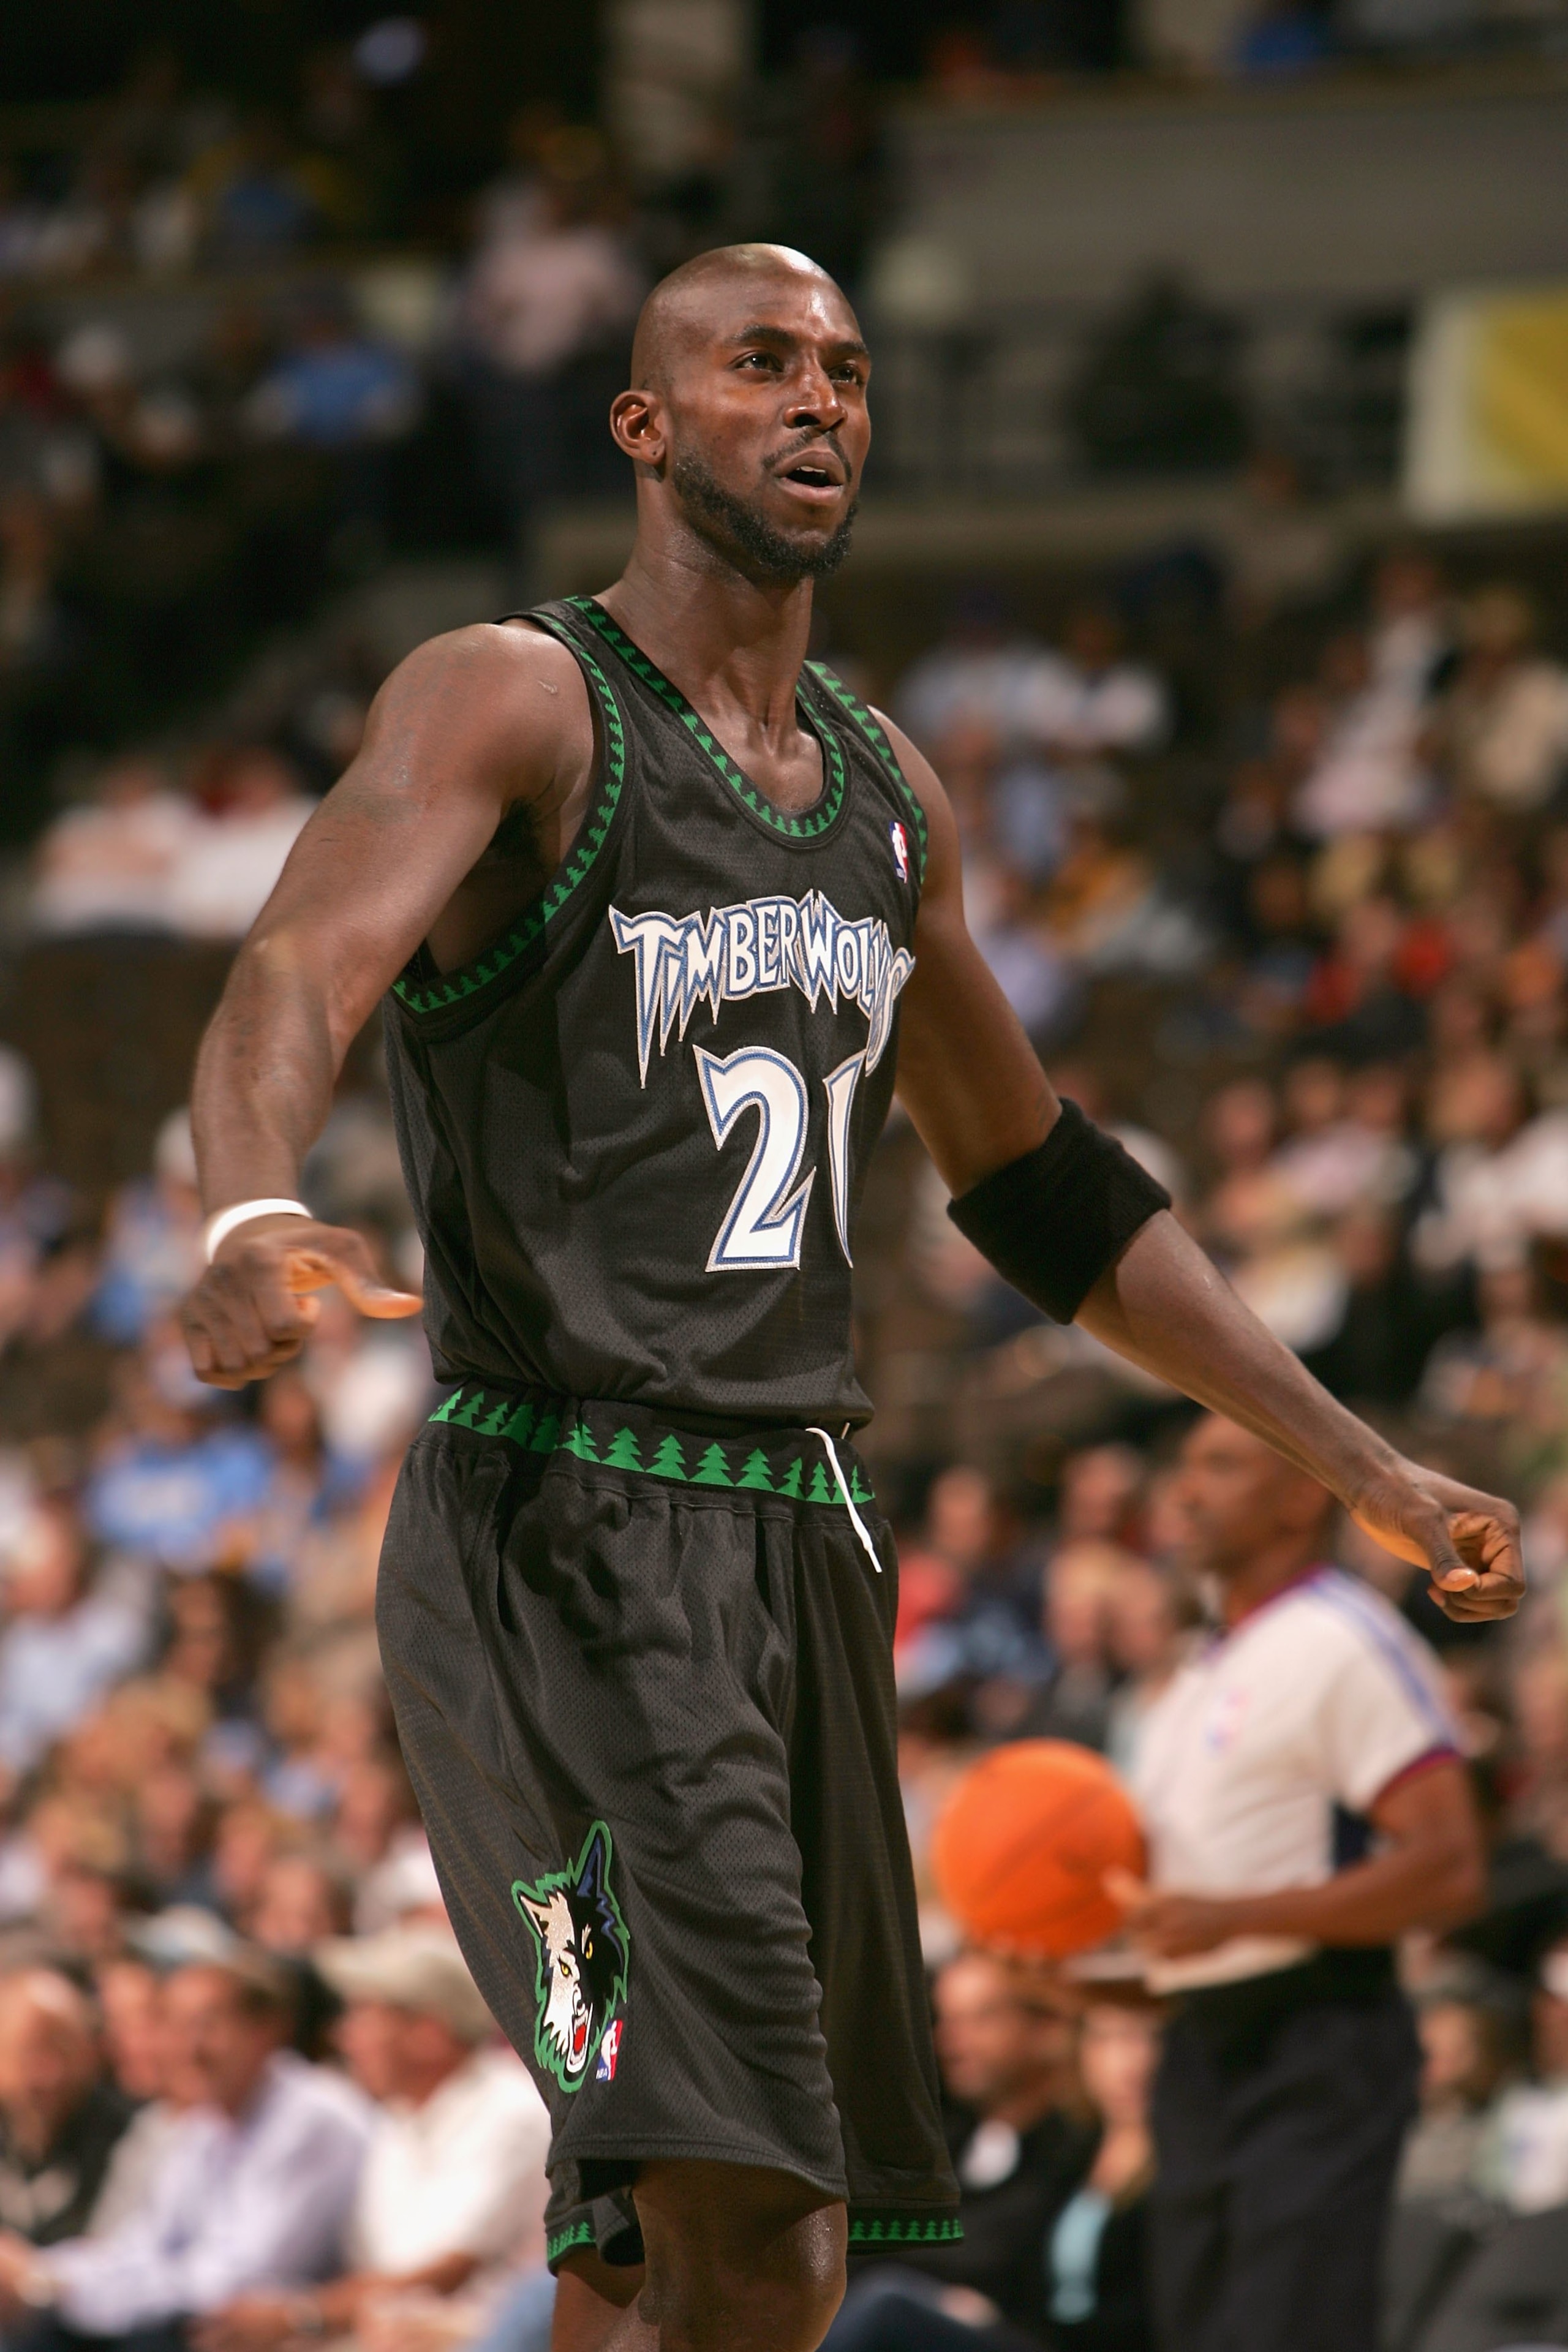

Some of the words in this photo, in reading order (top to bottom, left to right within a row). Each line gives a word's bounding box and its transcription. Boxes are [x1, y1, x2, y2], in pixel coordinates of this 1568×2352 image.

[608, 890, 916, 1089] TIMBERWOLVS
[693, 1044, 866, 1272] 21
[596, 2067, 608, 2079] NBA
